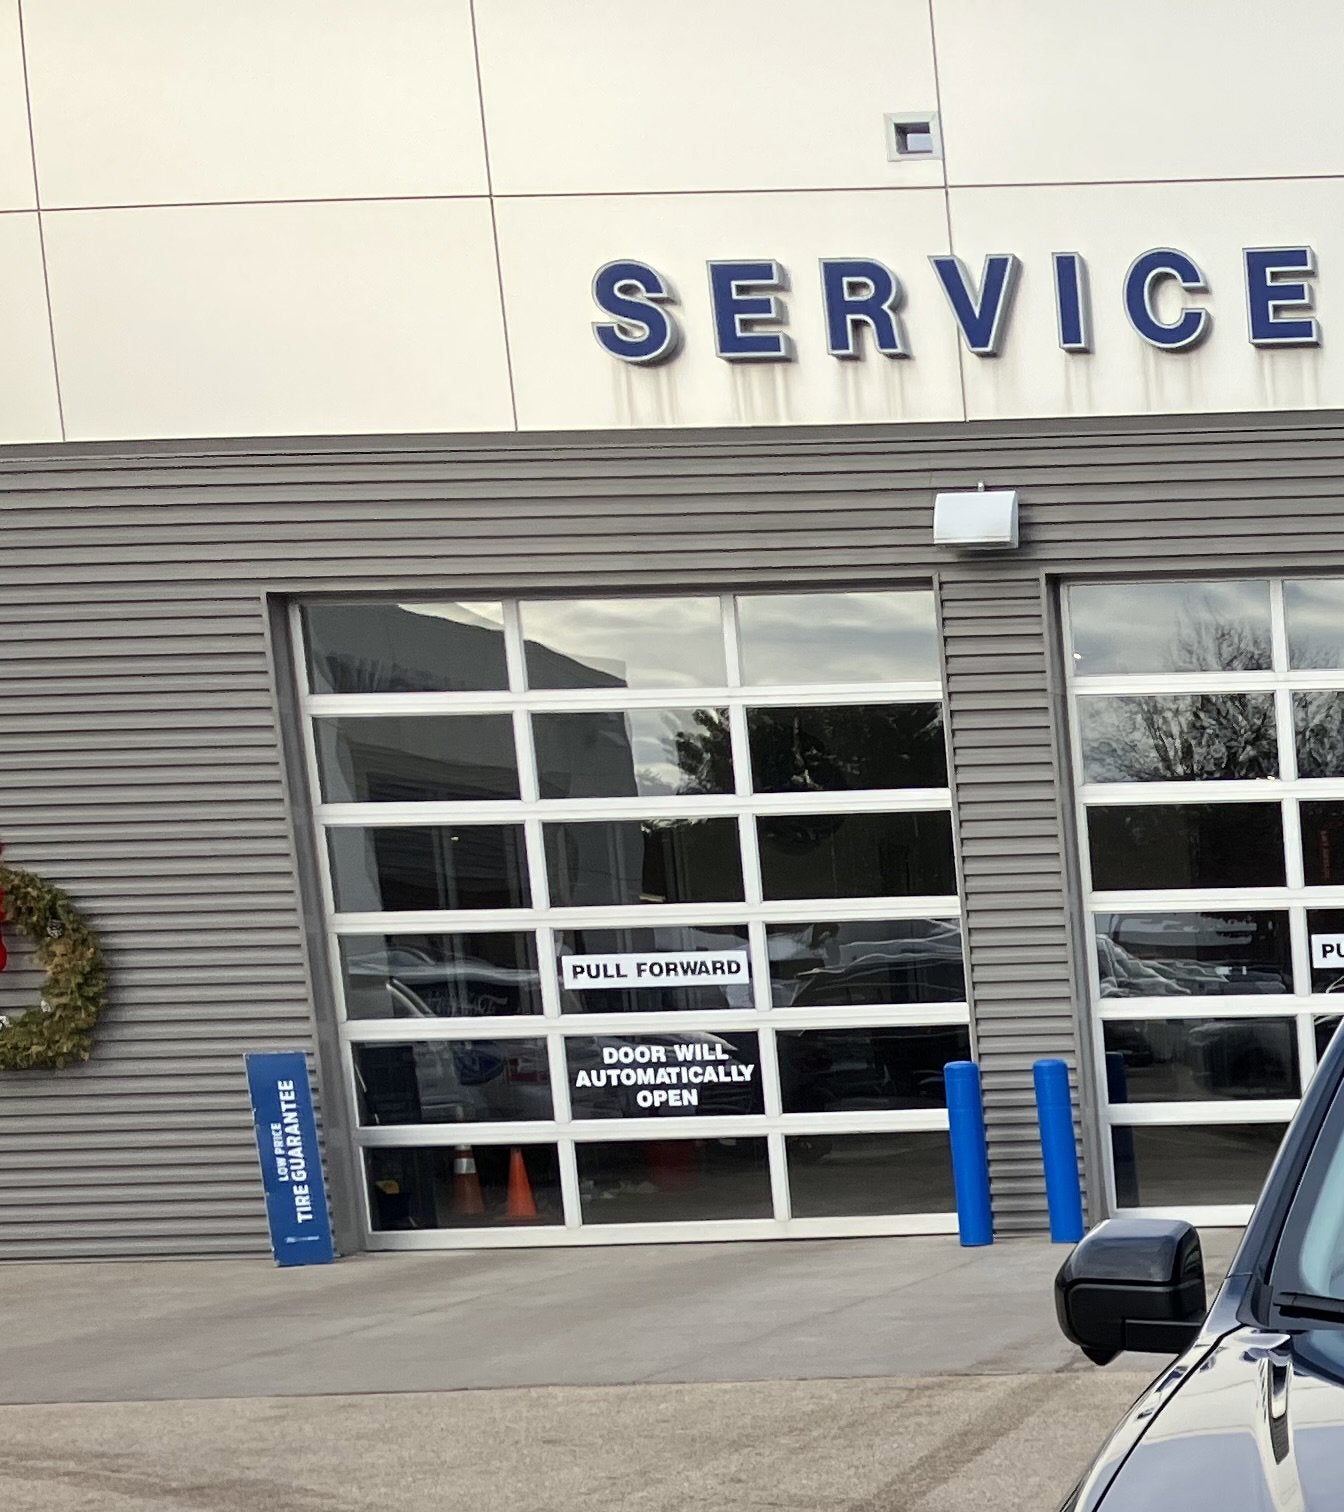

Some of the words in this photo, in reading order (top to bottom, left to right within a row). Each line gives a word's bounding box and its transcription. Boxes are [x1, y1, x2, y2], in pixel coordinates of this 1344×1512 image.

[591, 246, 1322, 367] SERVICE
[572, 963, 628, 980] PULL
[636, 960, 742, 978] FORWARD
[602, 1045, 667, 1065] DOOR
[674, 1043, 729, 1062] WILL
[575, 1064, 755, 1088] AUTOMATICALLY
[636, 1088, 699, 1108] OPEN
[270, 1122, 283, 1157] PRICE
[277, 1079, 308, 1182] GUARANTEE
[275, 1157, 289, 1182] LOW
[293, 1184, 314, 1224] TIRE
